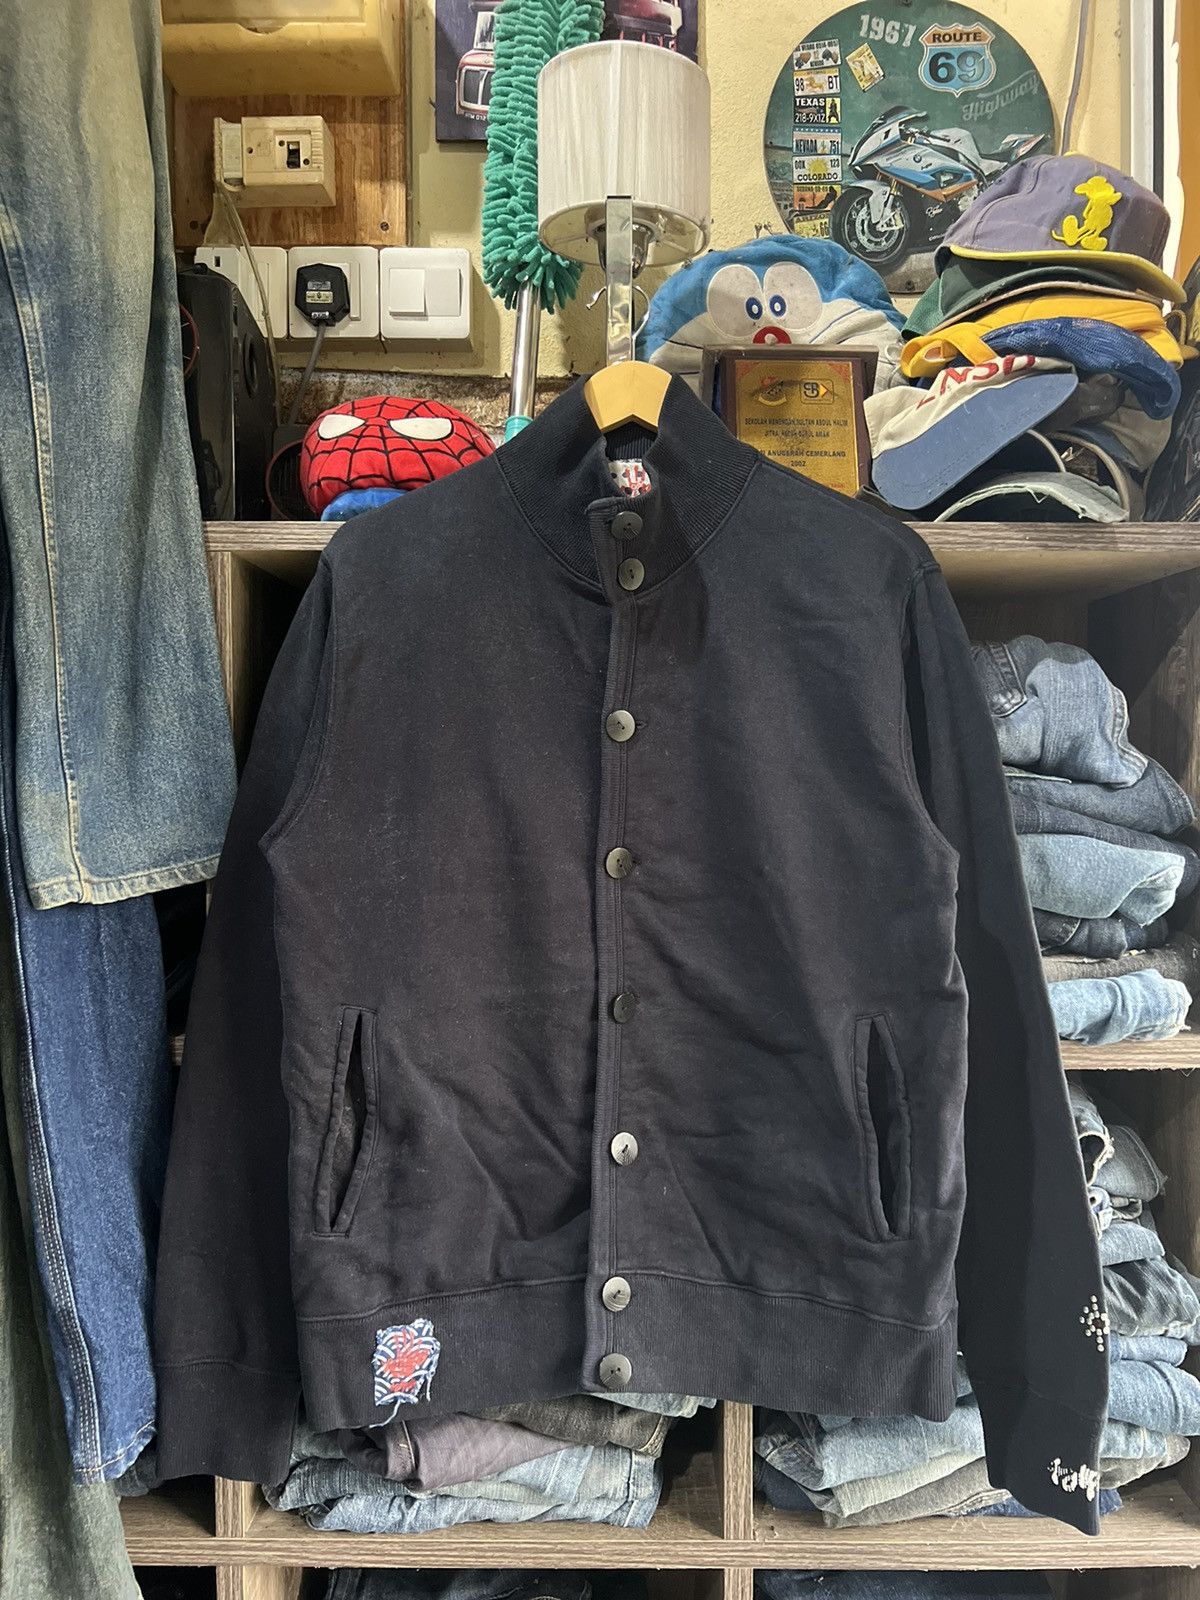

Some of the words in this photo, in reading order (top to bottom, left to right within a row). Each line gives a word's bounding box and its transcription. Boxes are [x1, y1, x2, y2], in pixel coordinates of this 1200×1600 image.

[859, 14, 917, 48] 1967
[932, 32, 982, 43] ROUTE
[929, 50, 985, 84] 69
[828, 75, 838, 89] BT
[795, 97, 825, 106] TEXAS
[962, 72, 1040, 121] Highway
[797, 172, 838, 182] COLORADO
[805, 450, 846, 458] CEMERLANG
